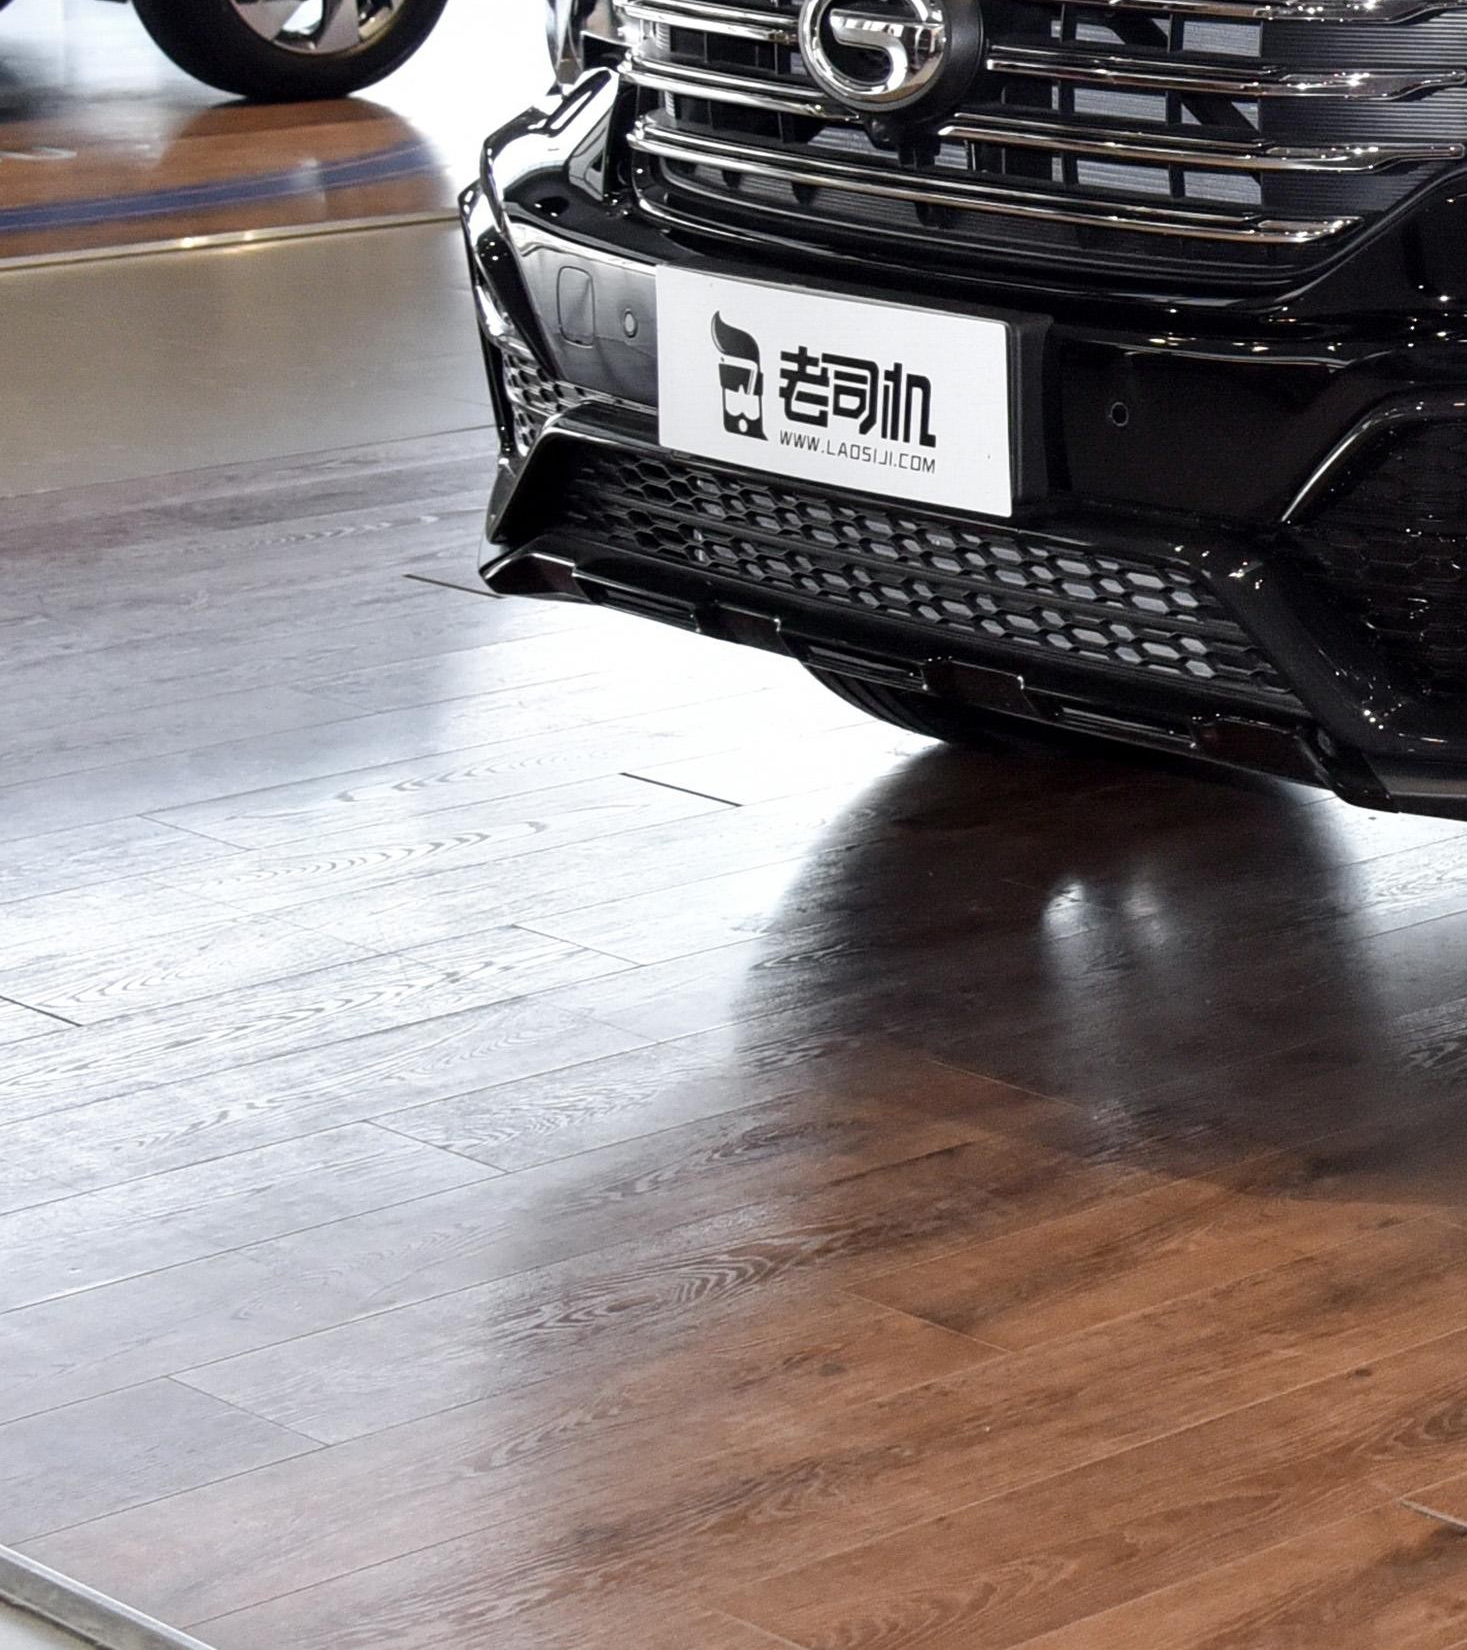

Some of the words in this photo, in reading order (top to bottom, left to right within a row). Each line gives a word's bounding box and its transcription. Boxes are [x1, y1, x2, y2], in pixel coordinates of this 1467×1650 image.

[779, 346, 936, 448] 老司机
[780, 430, 936, 475] WWW.LAOSIJI.COM
